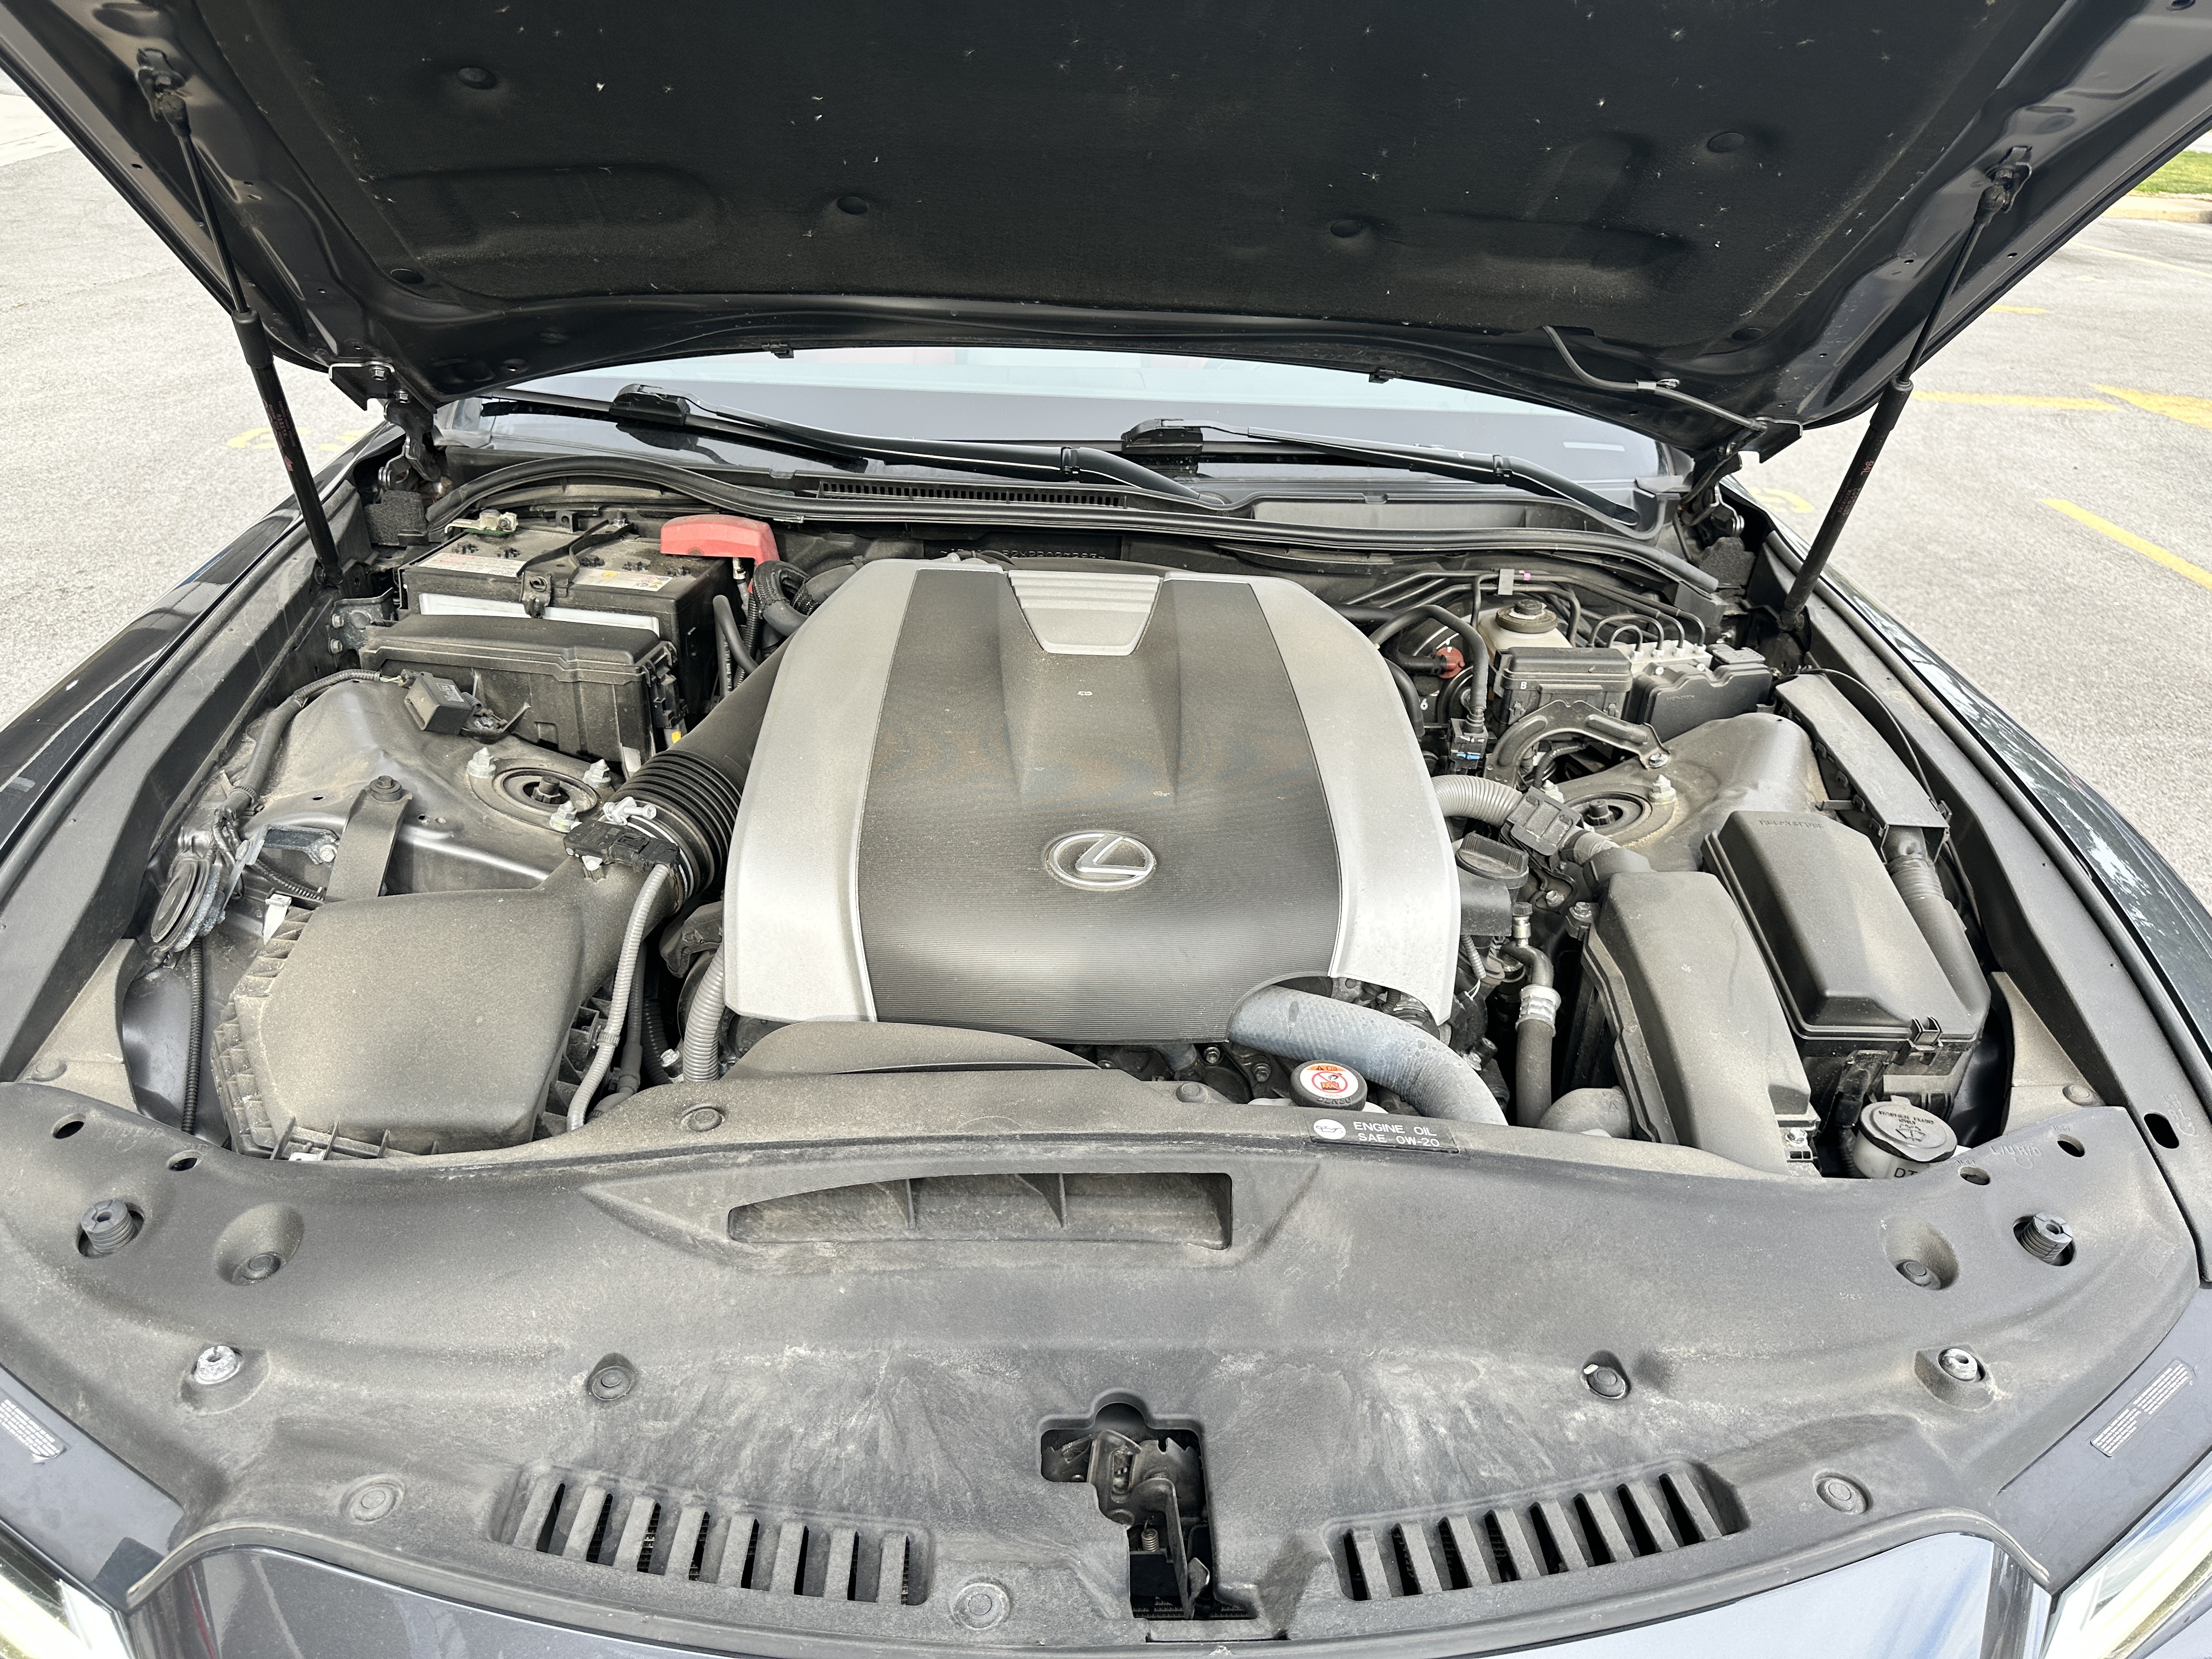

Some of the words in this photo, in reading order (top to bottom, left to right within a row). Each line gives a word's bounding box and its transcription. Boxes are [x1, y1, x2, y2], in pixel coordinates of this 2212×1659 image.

[1520, 681, 1527, 690] B
[1353, 1121, 1406, 1134] ENGINE
[1413, 1126, 1437, 1137] OIL
[1357, 1132, 1387, 1143] SAE
[1396, 1135, 1440, 1147] 0W-20
